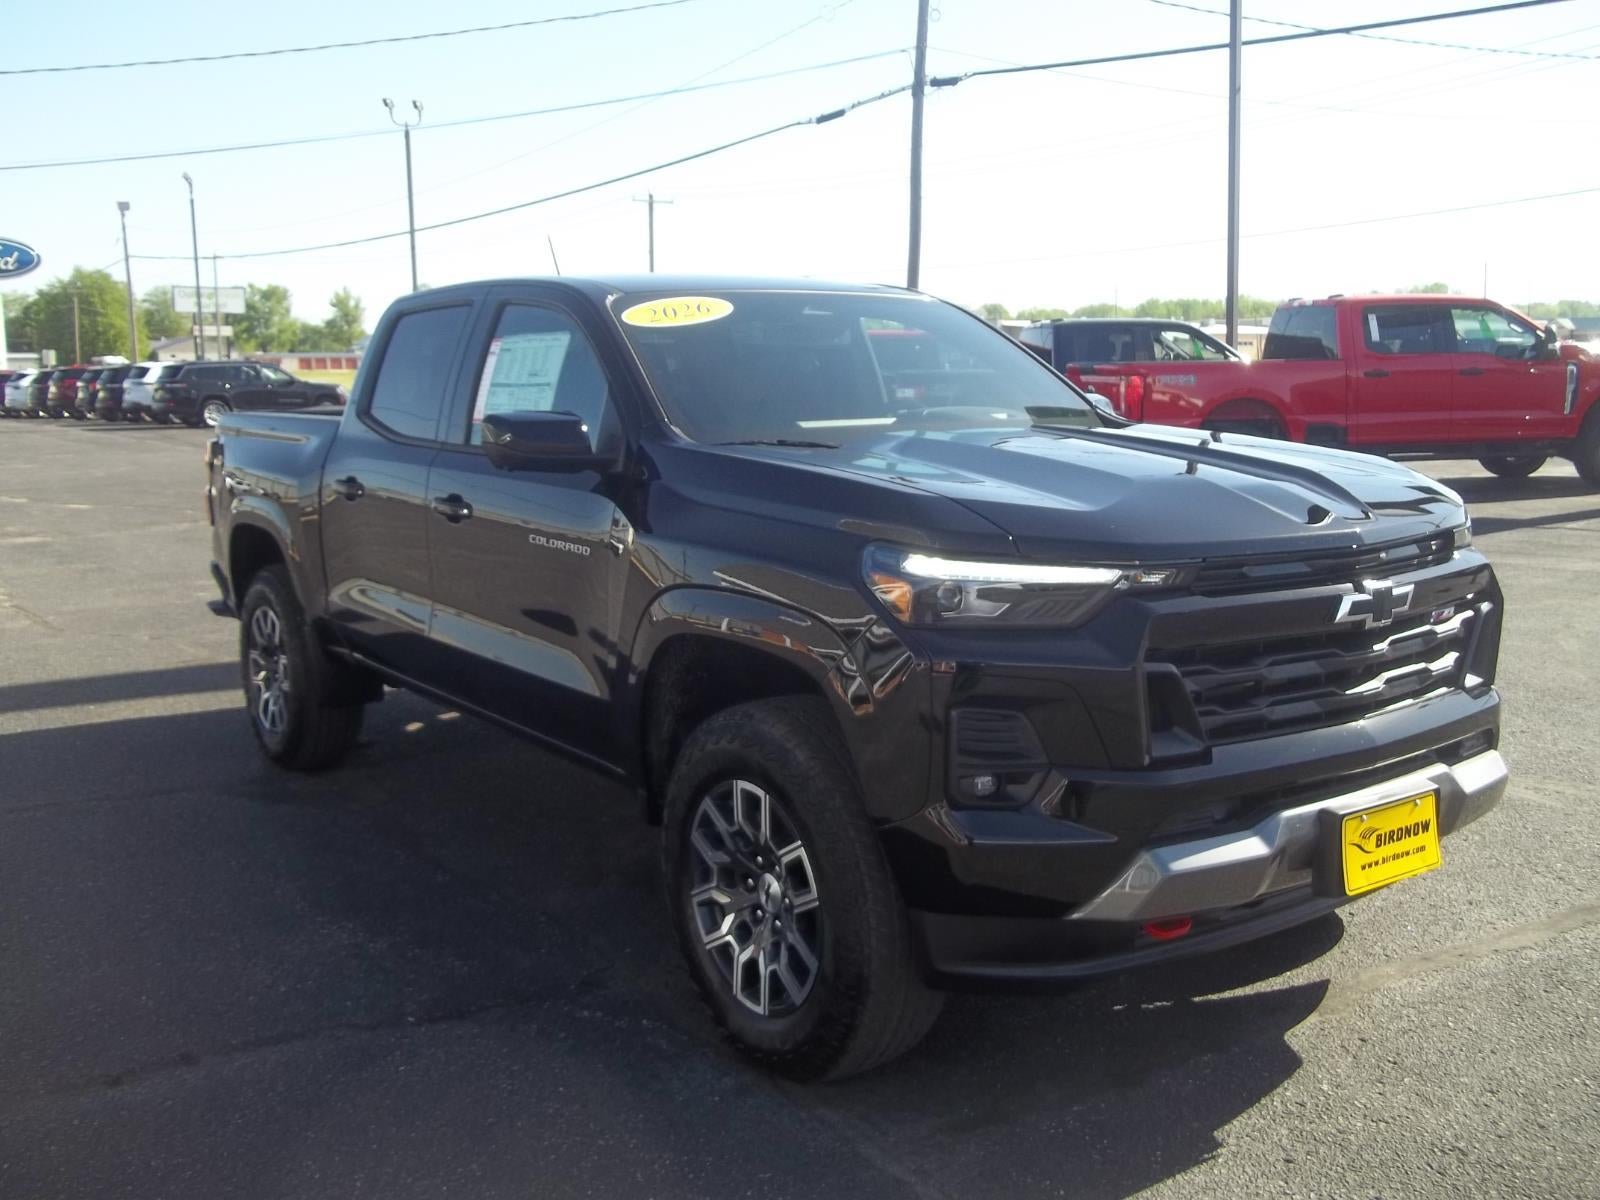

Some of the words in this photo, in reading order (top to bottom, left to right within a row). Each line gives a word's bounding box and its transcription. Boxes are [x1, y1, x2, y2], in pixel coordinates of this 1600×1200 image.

[648, 303, 711, 323] 2026
[528, 534, 591, 556] COLORADO
[1375, 818, 1432, 849] BIRDNOW
[1360, 844, 1426, 872] www.birdnow.com
